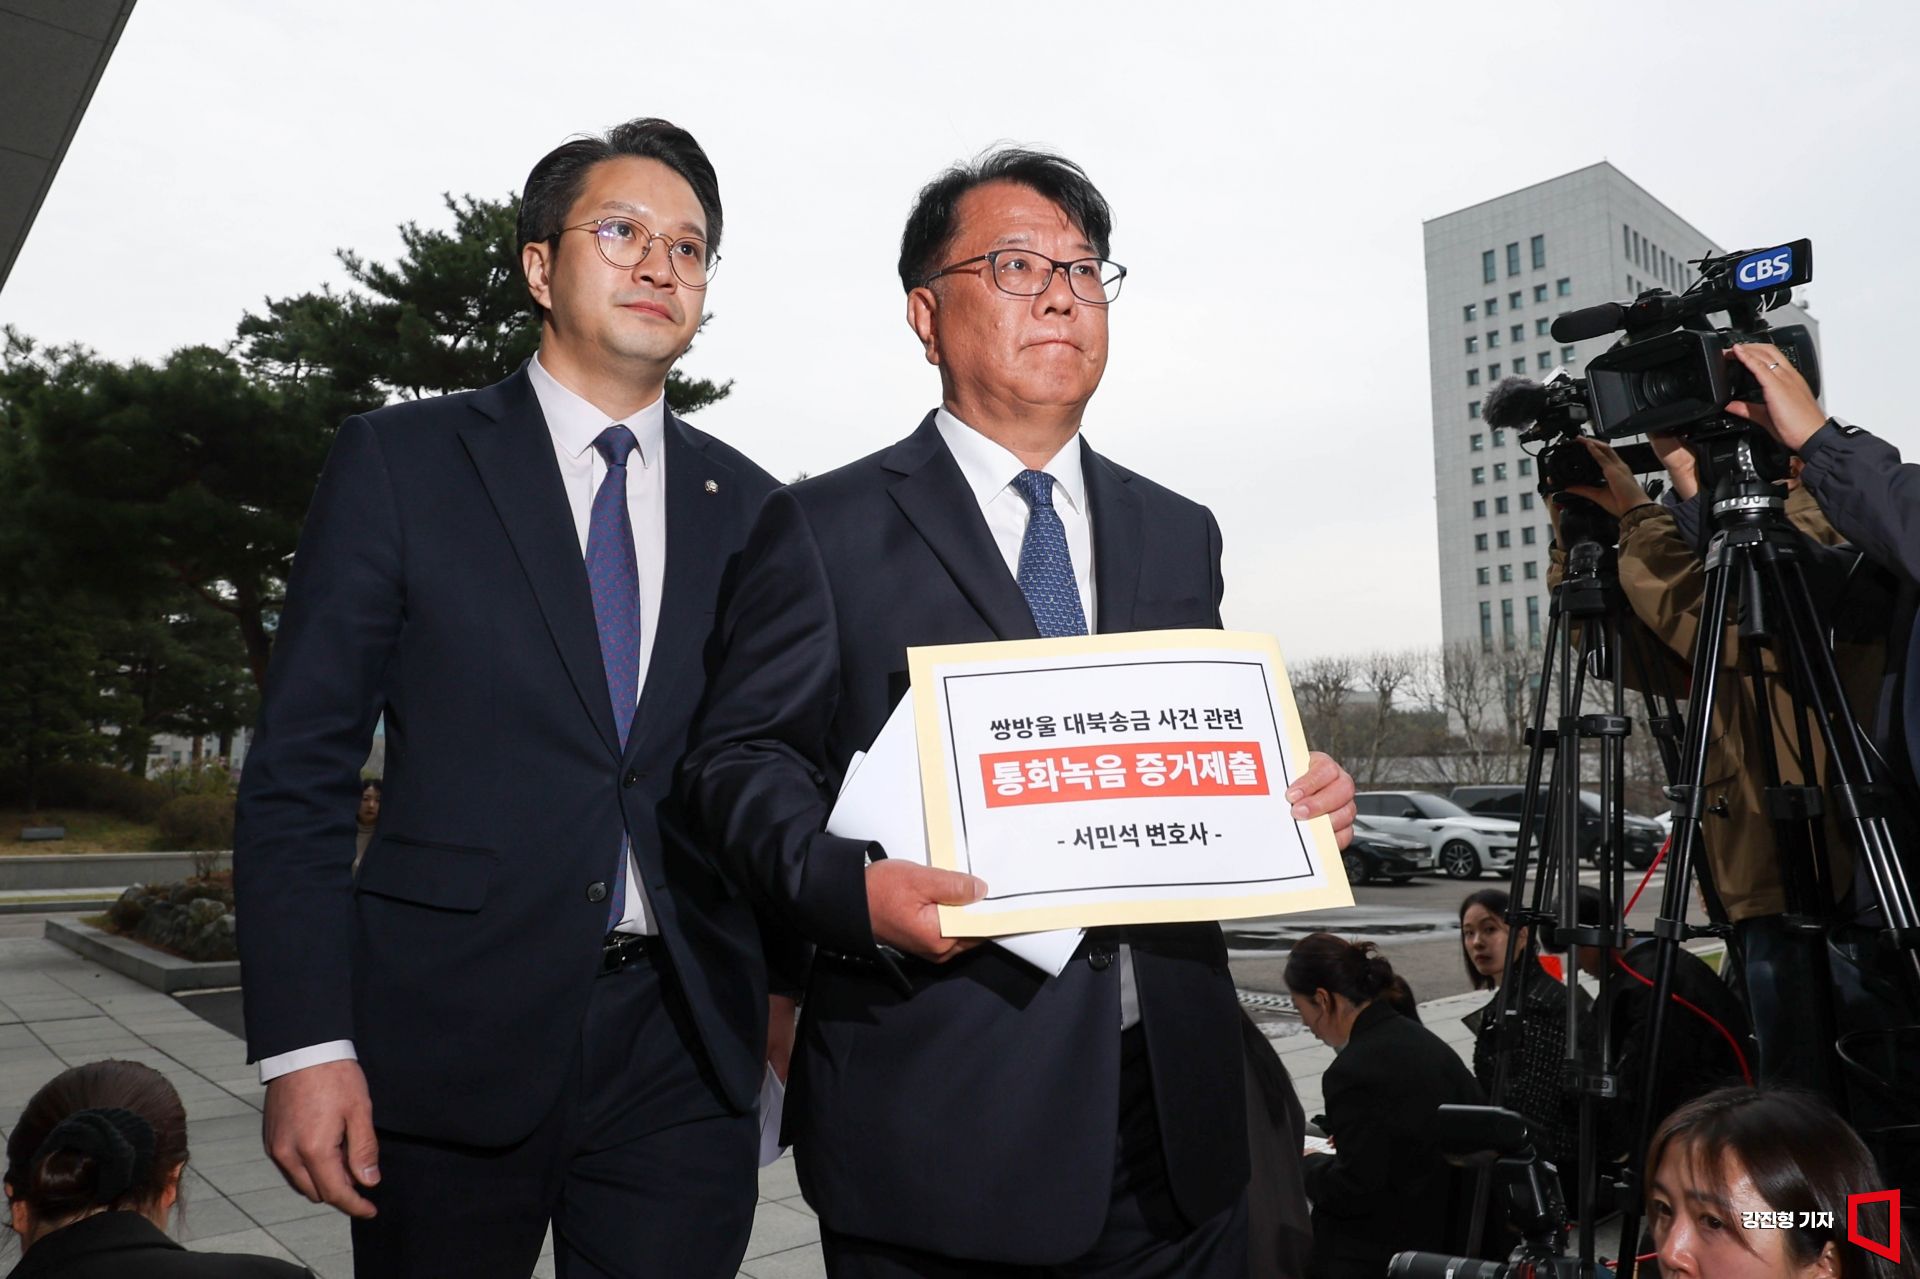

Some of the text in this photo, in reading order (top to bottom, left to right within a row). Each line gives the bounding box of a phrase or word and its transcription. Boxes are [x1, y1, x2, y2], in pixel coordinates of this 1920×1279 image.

[1740, 253, 1790, 283] CBS
[990, 706, 1244, 741] 쌍방울 대북송금 사건 관련
[992, 750, 1258, 797] 통화녹음 증거제출
[1073, 823, 1140, 851] 서민석
[1145, 821, 1208, 848] 변호사
